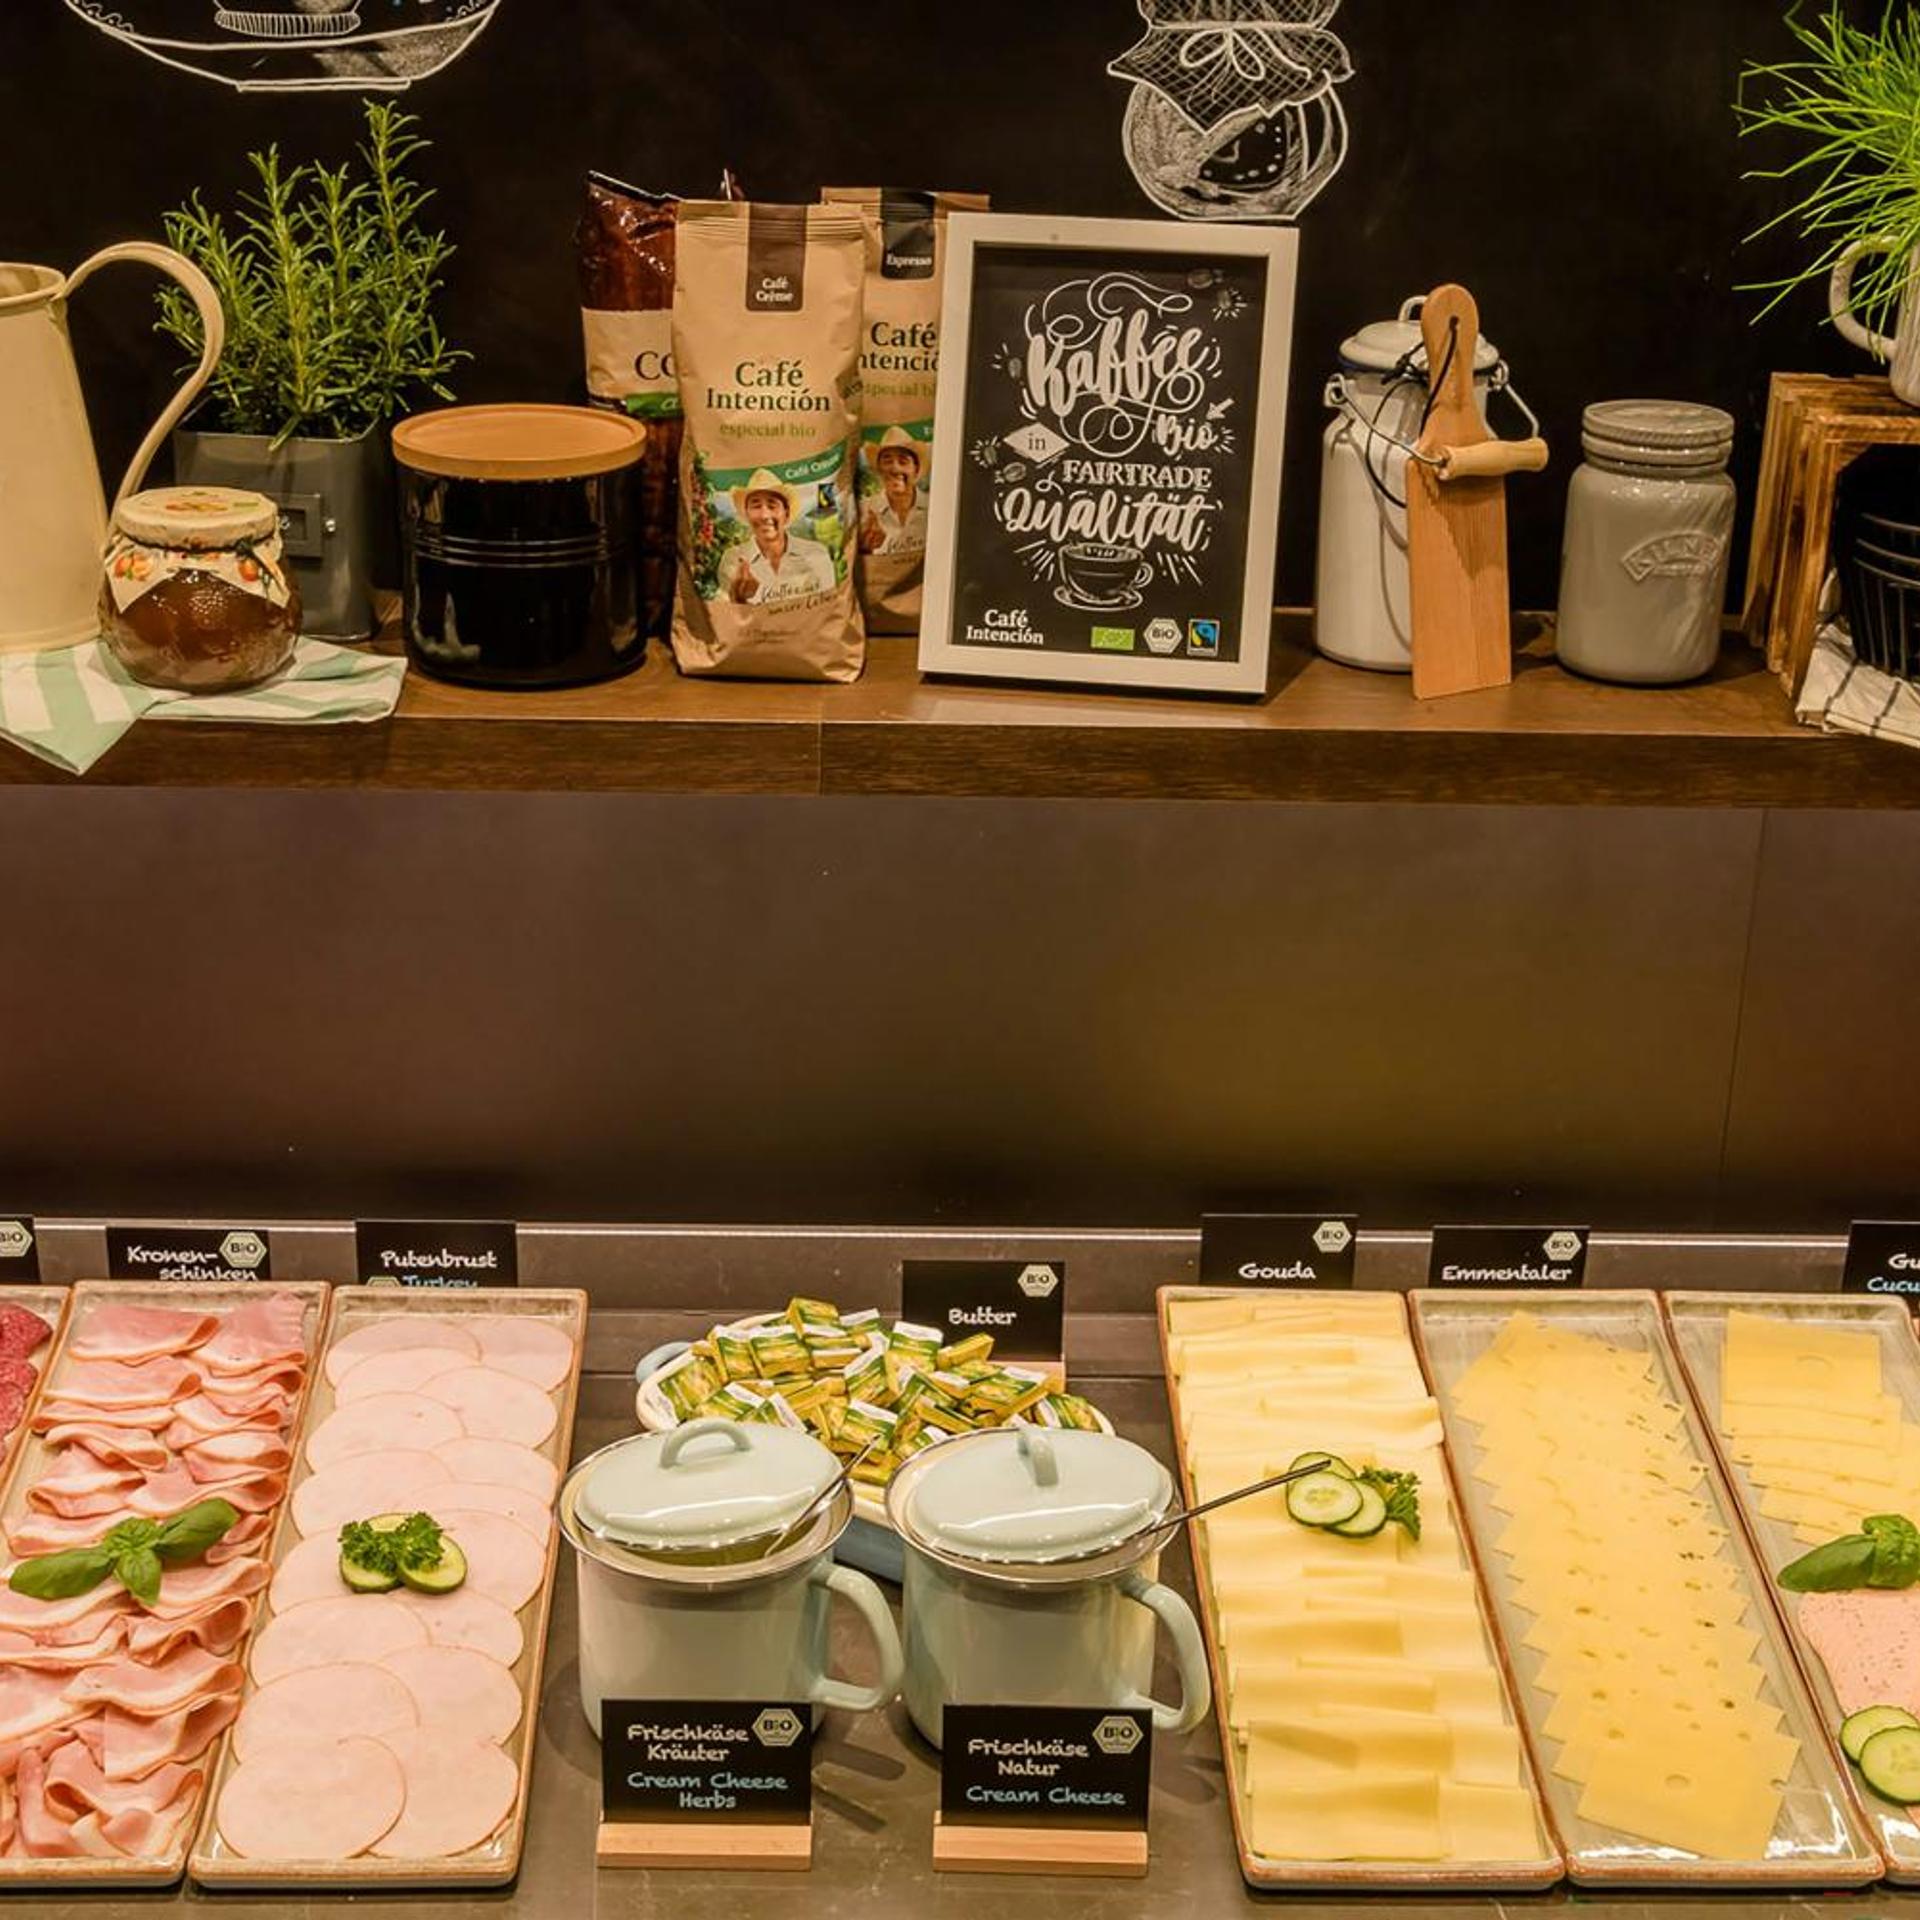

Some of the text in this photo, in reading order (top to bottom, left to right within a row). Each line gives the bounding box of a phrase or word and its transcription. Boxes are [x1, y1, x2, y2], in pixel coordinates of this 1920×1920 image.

[762, 275, 789, 289] Café
[871, 321, 936, 348] Café
[858, 351, 939, 371] ntenció
[1025, 305, 1204, 418] Kaffee
[735, 360, 804, 387] Café
[706, 388, 830, 411] Intención
[719, 423, 816, 438] especial bio
[1155, 414, 1217, 455] Bio
[1028, 433, 1046, 450] in
[1062, 460, 1212, 490] FAIRTRADE
[1003, 488, 1215, 550] Qualität
[985, 609, 1028, 627] Café
[966, 625, 1043, 645] Intención
[127, 1246, 218, 1263] Kronen-
[381, 1249, 497, 1268] Putenbrust
[160, 1263, 257, 1281] schinken
[1239, 1261, 1316, 1279] Gouda
[1442, 1264, 1572, 1280] Emmentaler
[949, 1306, 1017, 1325] Butter
[627, 1723, 749, 1742] Frischkäse
[647, 1743, 730, 1762] Kräuter
[967, 1739, 1090, 1758] Frischkäse
[997, 1758, 1060, 1777] Natur
[627, 1772, 788, 1789] Cream Cheese
[679, 1791, 736, 1809] Herbs
[966, 1785, 1126, 1805] Cream Cheese
